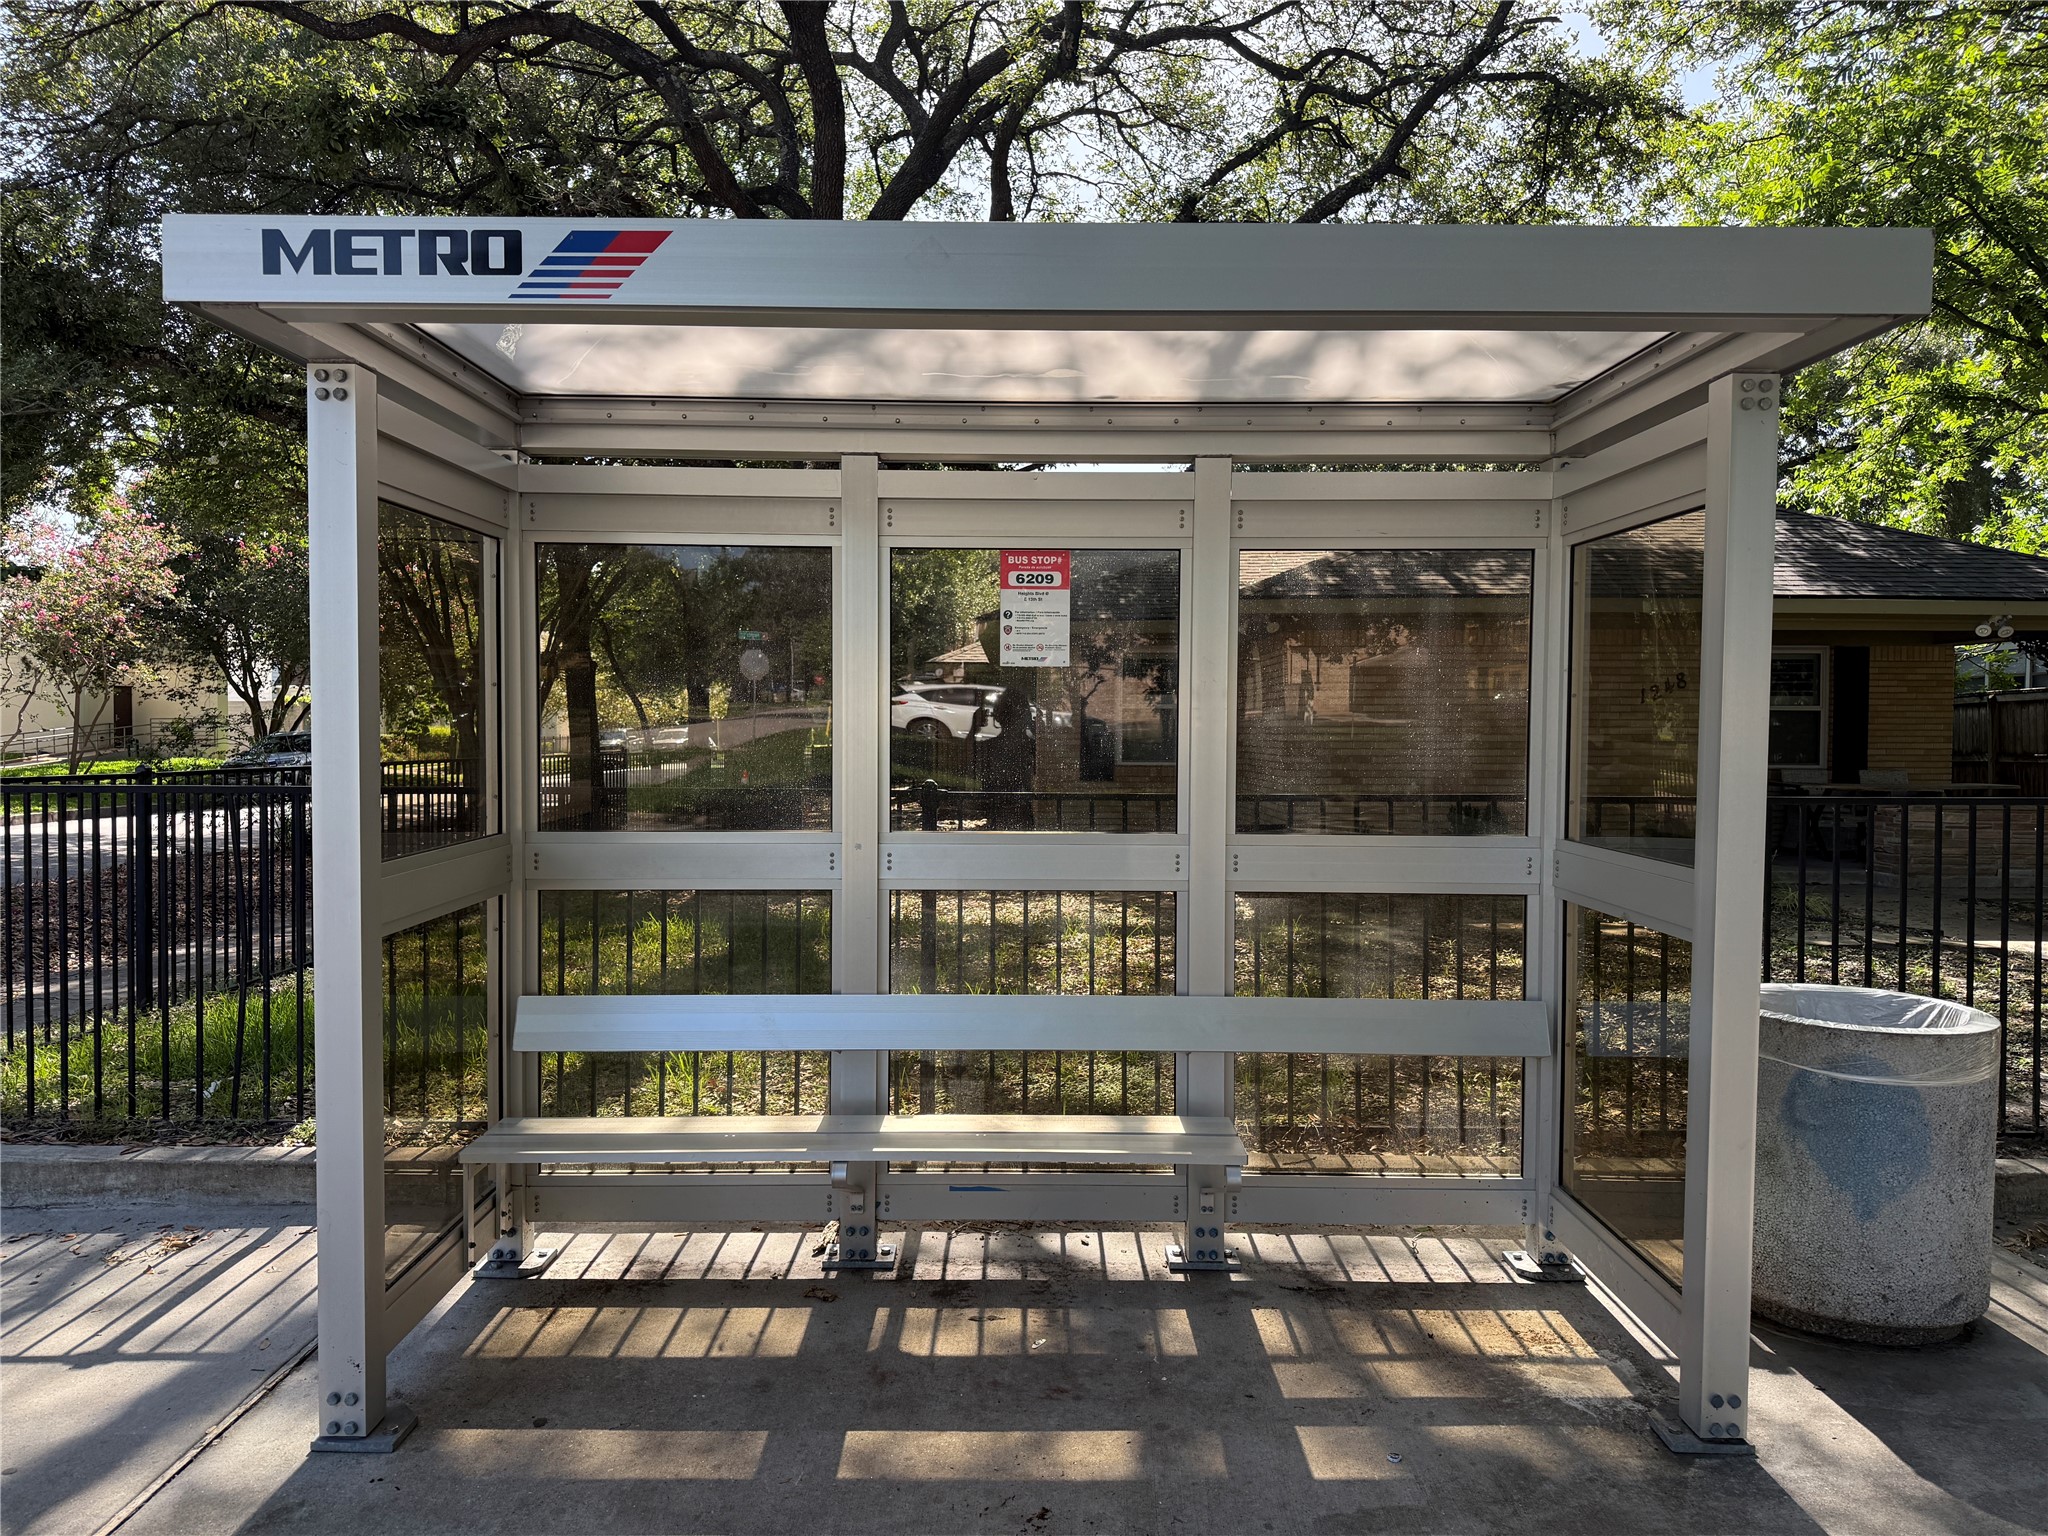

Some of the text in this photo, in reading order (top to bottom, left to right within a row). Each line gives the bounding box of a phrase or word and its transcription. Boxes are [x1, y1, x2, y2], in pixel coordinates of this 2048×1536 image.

[262, 229, 523, 276] METRO
[1008, 556, 1028, 564] BUS
[1015, 574, 1054, 584] 6209
[1640, 672, 1687, 704] 1248
